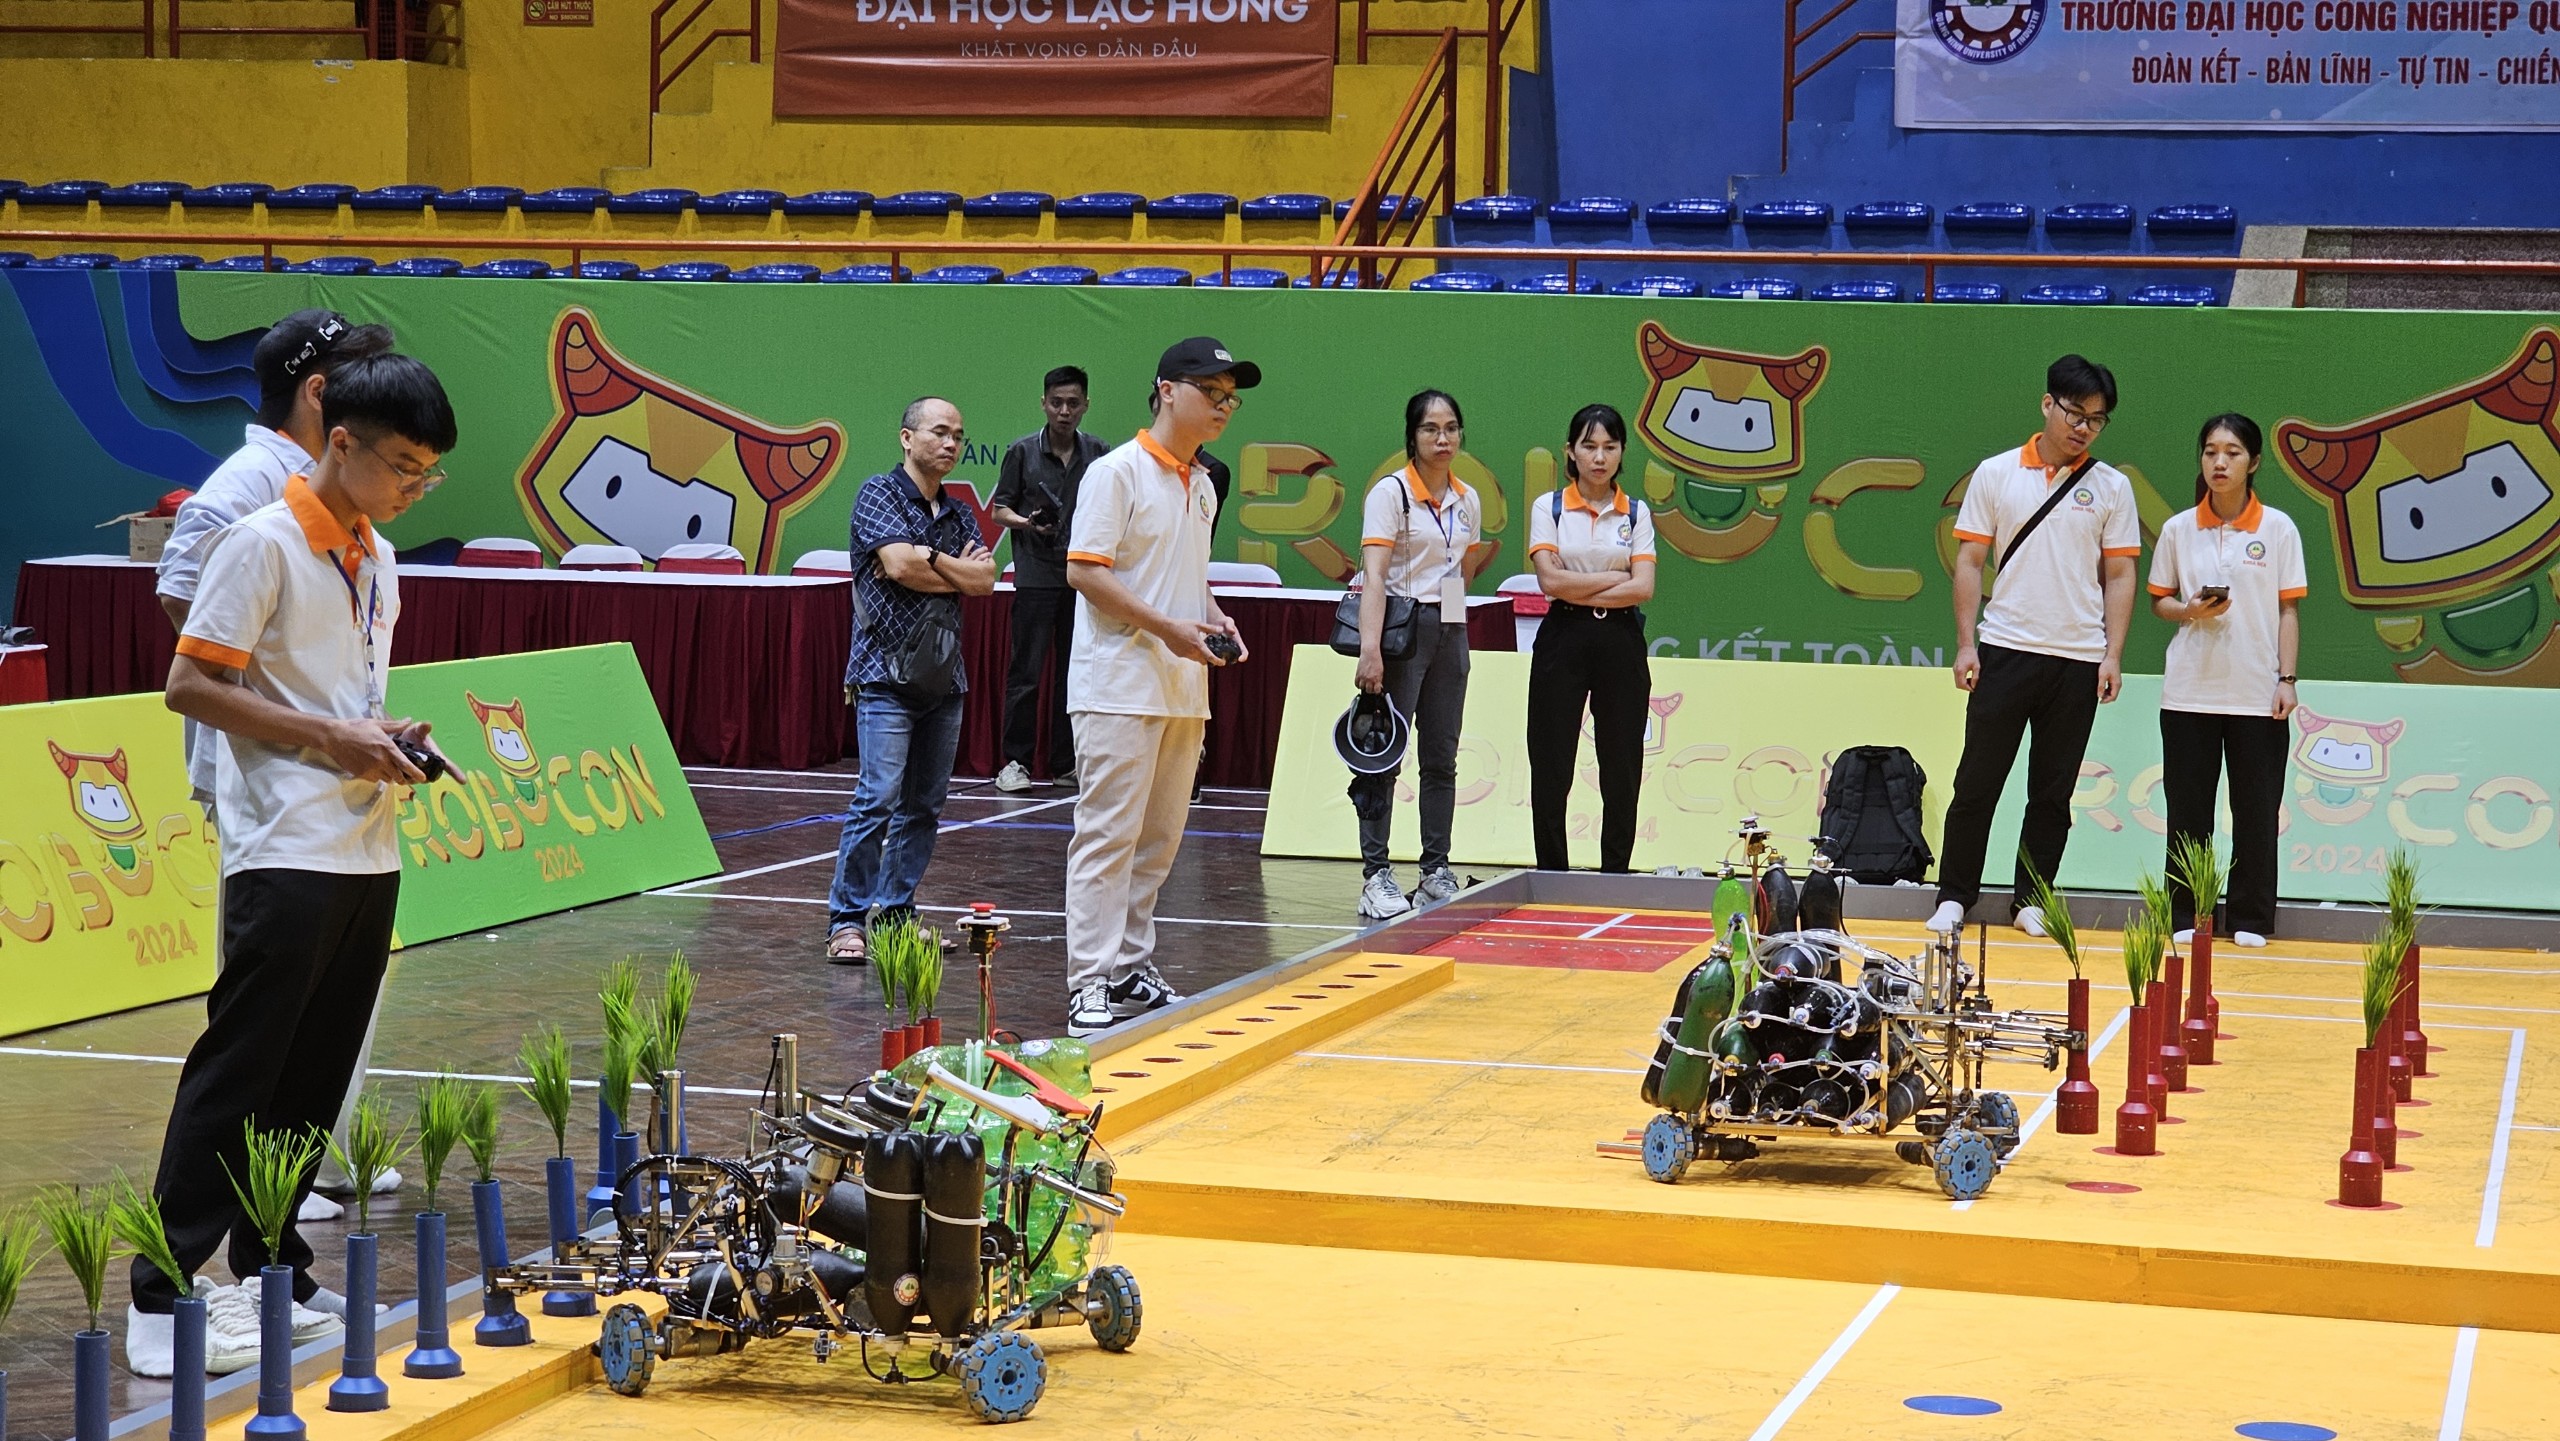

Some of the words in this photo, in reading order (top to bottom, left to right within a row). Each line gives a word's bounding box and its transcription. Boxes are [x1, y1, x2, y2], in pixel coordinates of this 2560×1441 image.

[856, 0, 936, 30] ĐẠI
[949, 0, 1053, 31] HỌC
[1066, 0, 1154, 31] LẠC
[2185, 1, 2235, 38] ĐẠI
[2245, 1, 2305, 38] HỌC
[1024, 42, 1088, 60] VỌNG
[1098, 37, 1143, 58] DẪN
[1152, 36, 1198, 58] ĐẦU
[1945, 35, 1963, 53] NINH
[1962, 47, 2008, 60] UNIVERSITY
[2007, 43, 2018, 53] OF
[2016, 10, 2041, 46] INDUSTRY
[2132, 52, 2192, 84] ĐOÀN
[2201, 47, 2241, 84] KẾT
[2266, 50, 2311, 84] BẢN
[2320, 52, 2371, 84] LĨNH
[2398, 54, 2428, 90] TỰ
[2432, 57, 2470, 85] TIN
[535, 844, 585, 883] 2024
[2289, 842, 2388, 877] 2024
[127, 918, 199, 968] 2024
